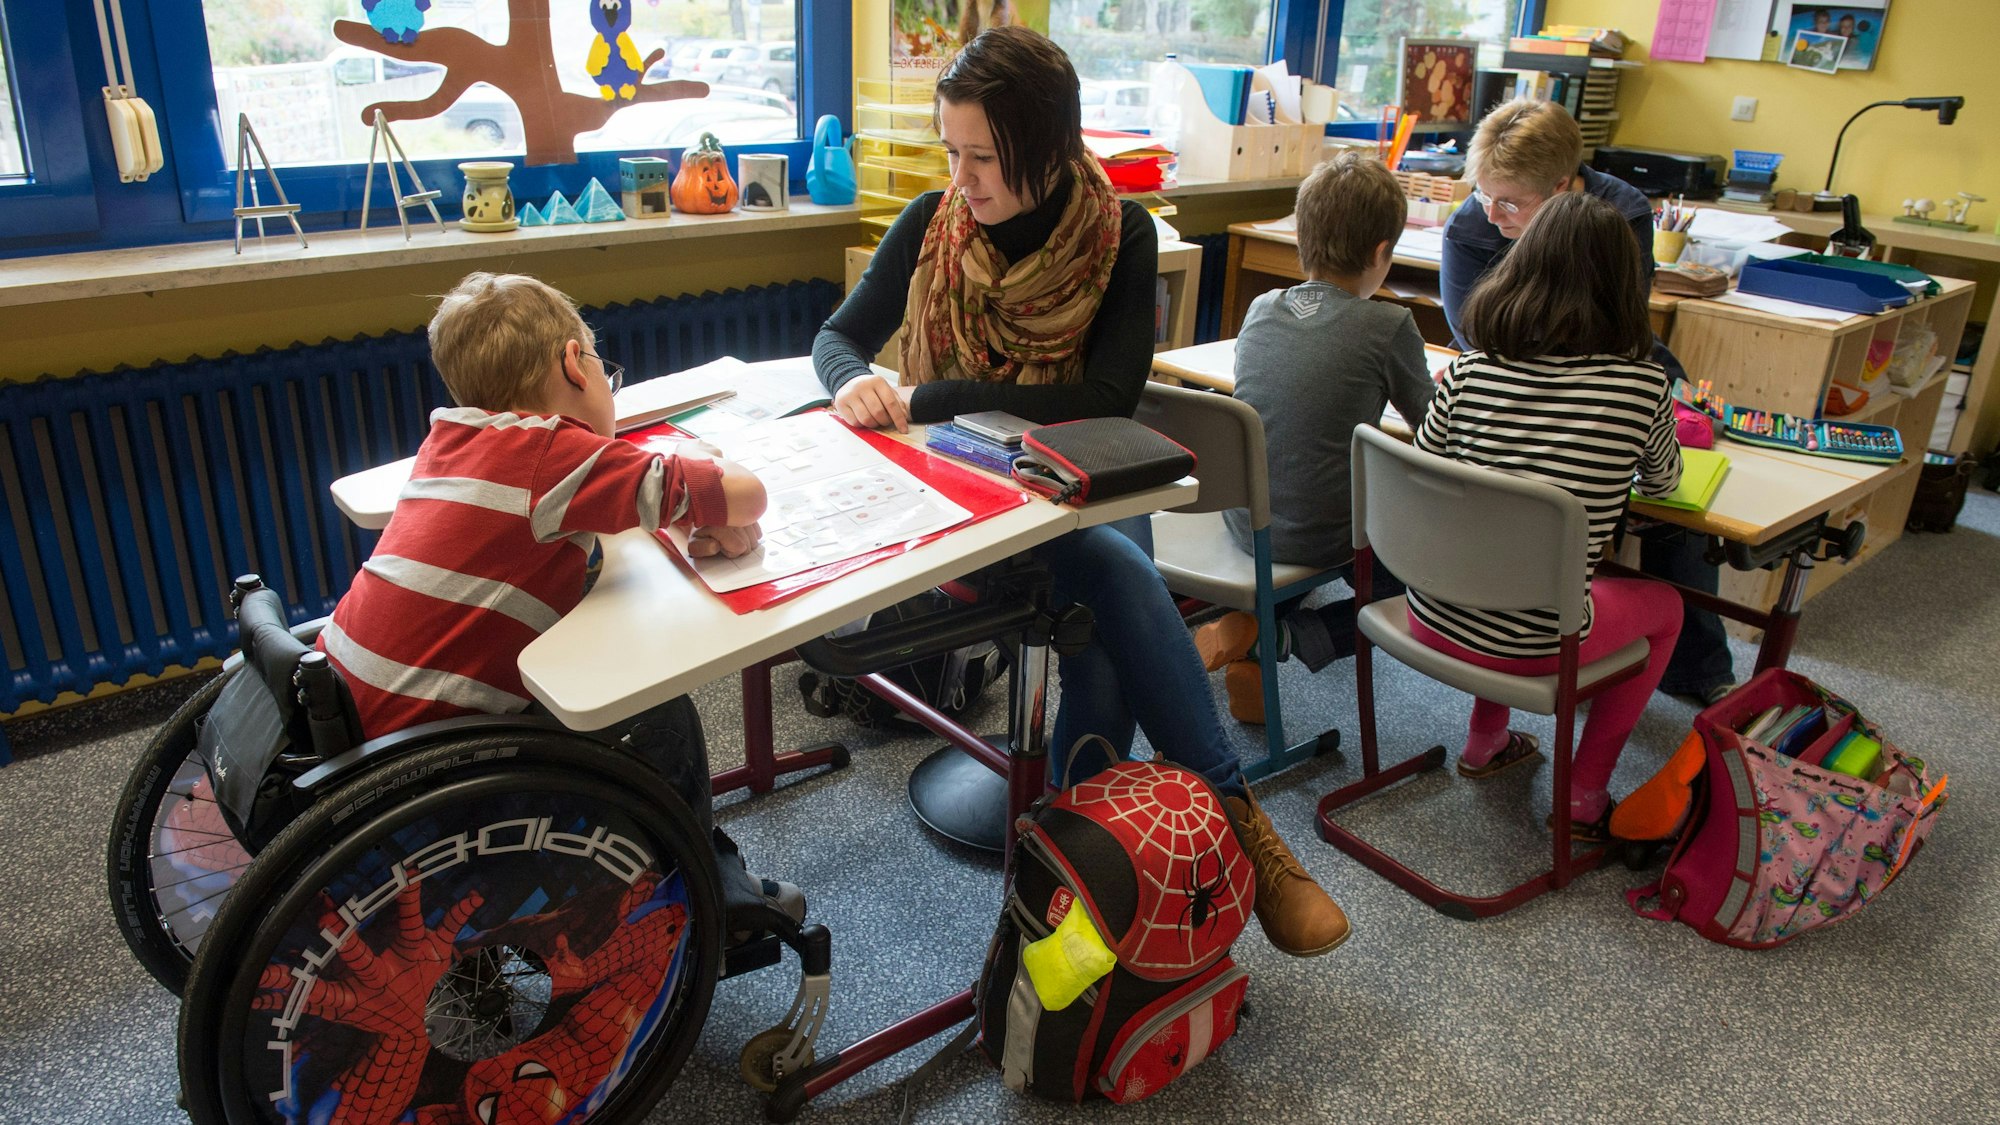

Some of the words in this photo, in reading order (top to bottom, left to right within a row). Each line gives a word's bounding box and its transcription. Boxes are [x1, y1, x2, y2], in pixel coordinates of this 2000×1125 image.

[900, 58, 945, 69] OKTOBER
[119, 764, 162, 872] MARATHON
[331, 746, 520, 826] SCHWALBE
